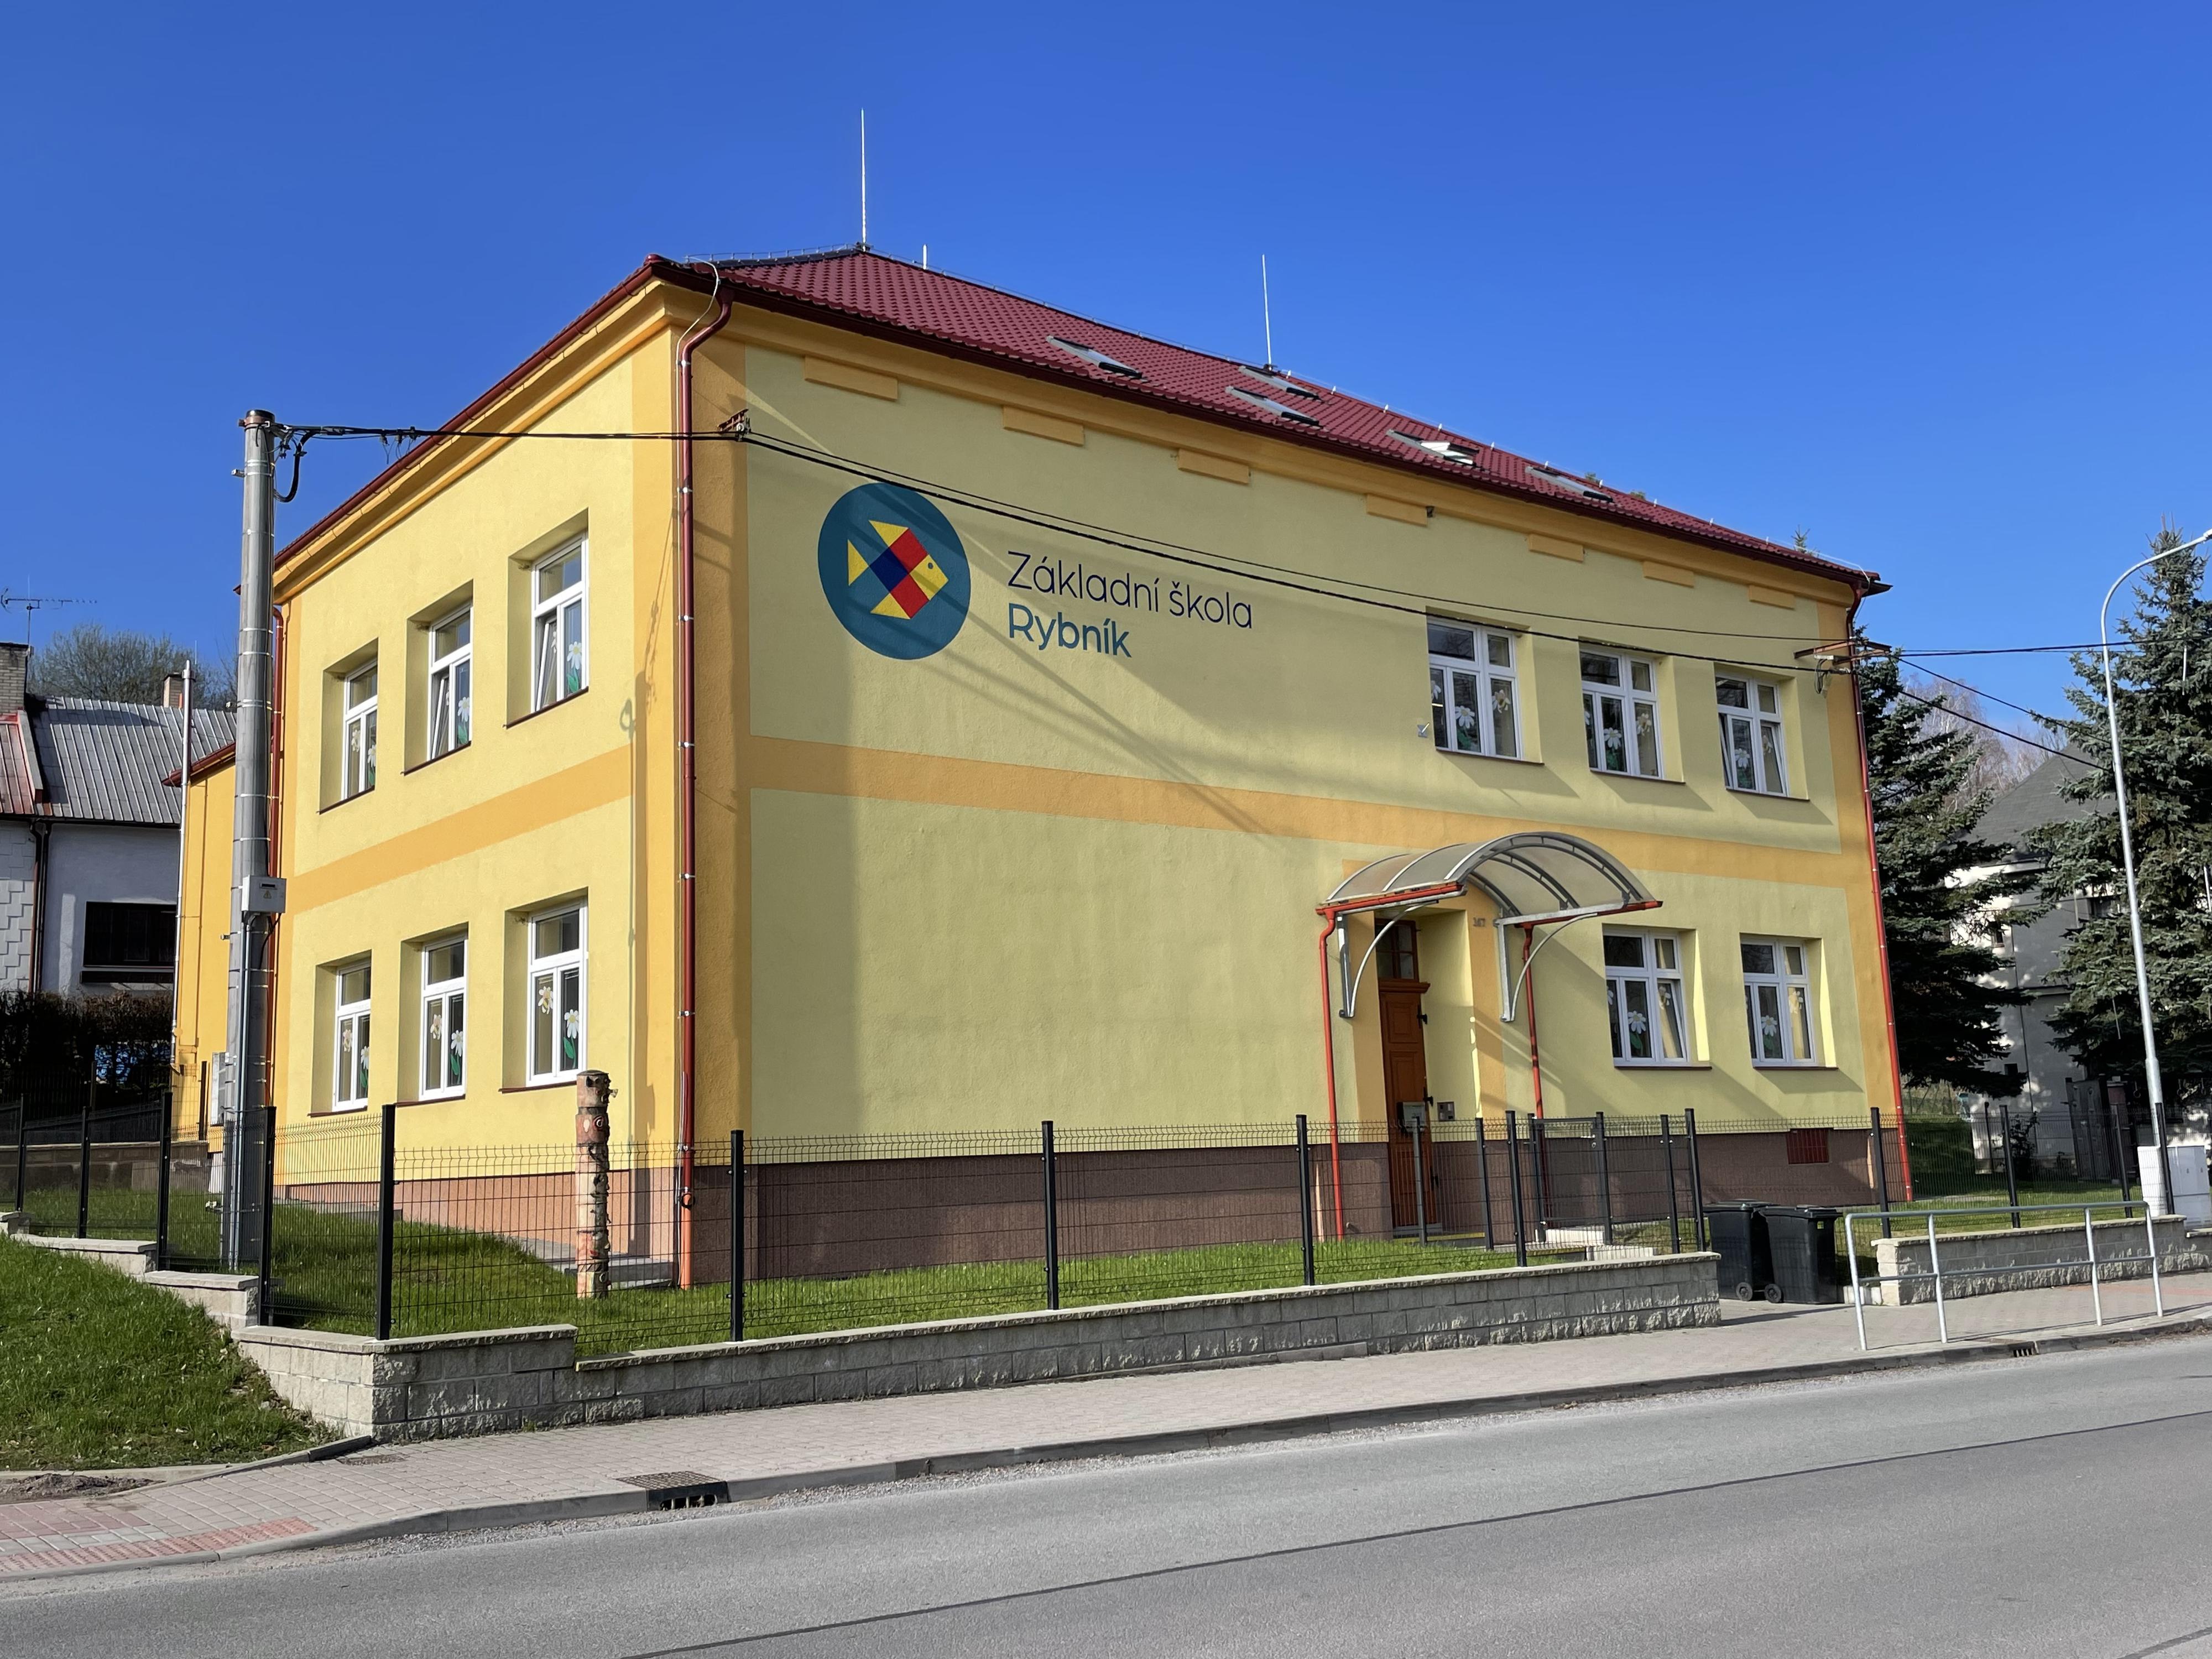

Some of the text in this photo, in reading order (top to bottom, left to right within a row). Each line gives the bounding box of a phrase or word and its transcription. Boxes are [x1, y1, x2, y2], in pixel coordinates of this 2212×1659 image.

[1008, 550, 1252, 629] Základní škola
[1009, 602, 1132, 658] Rybník
